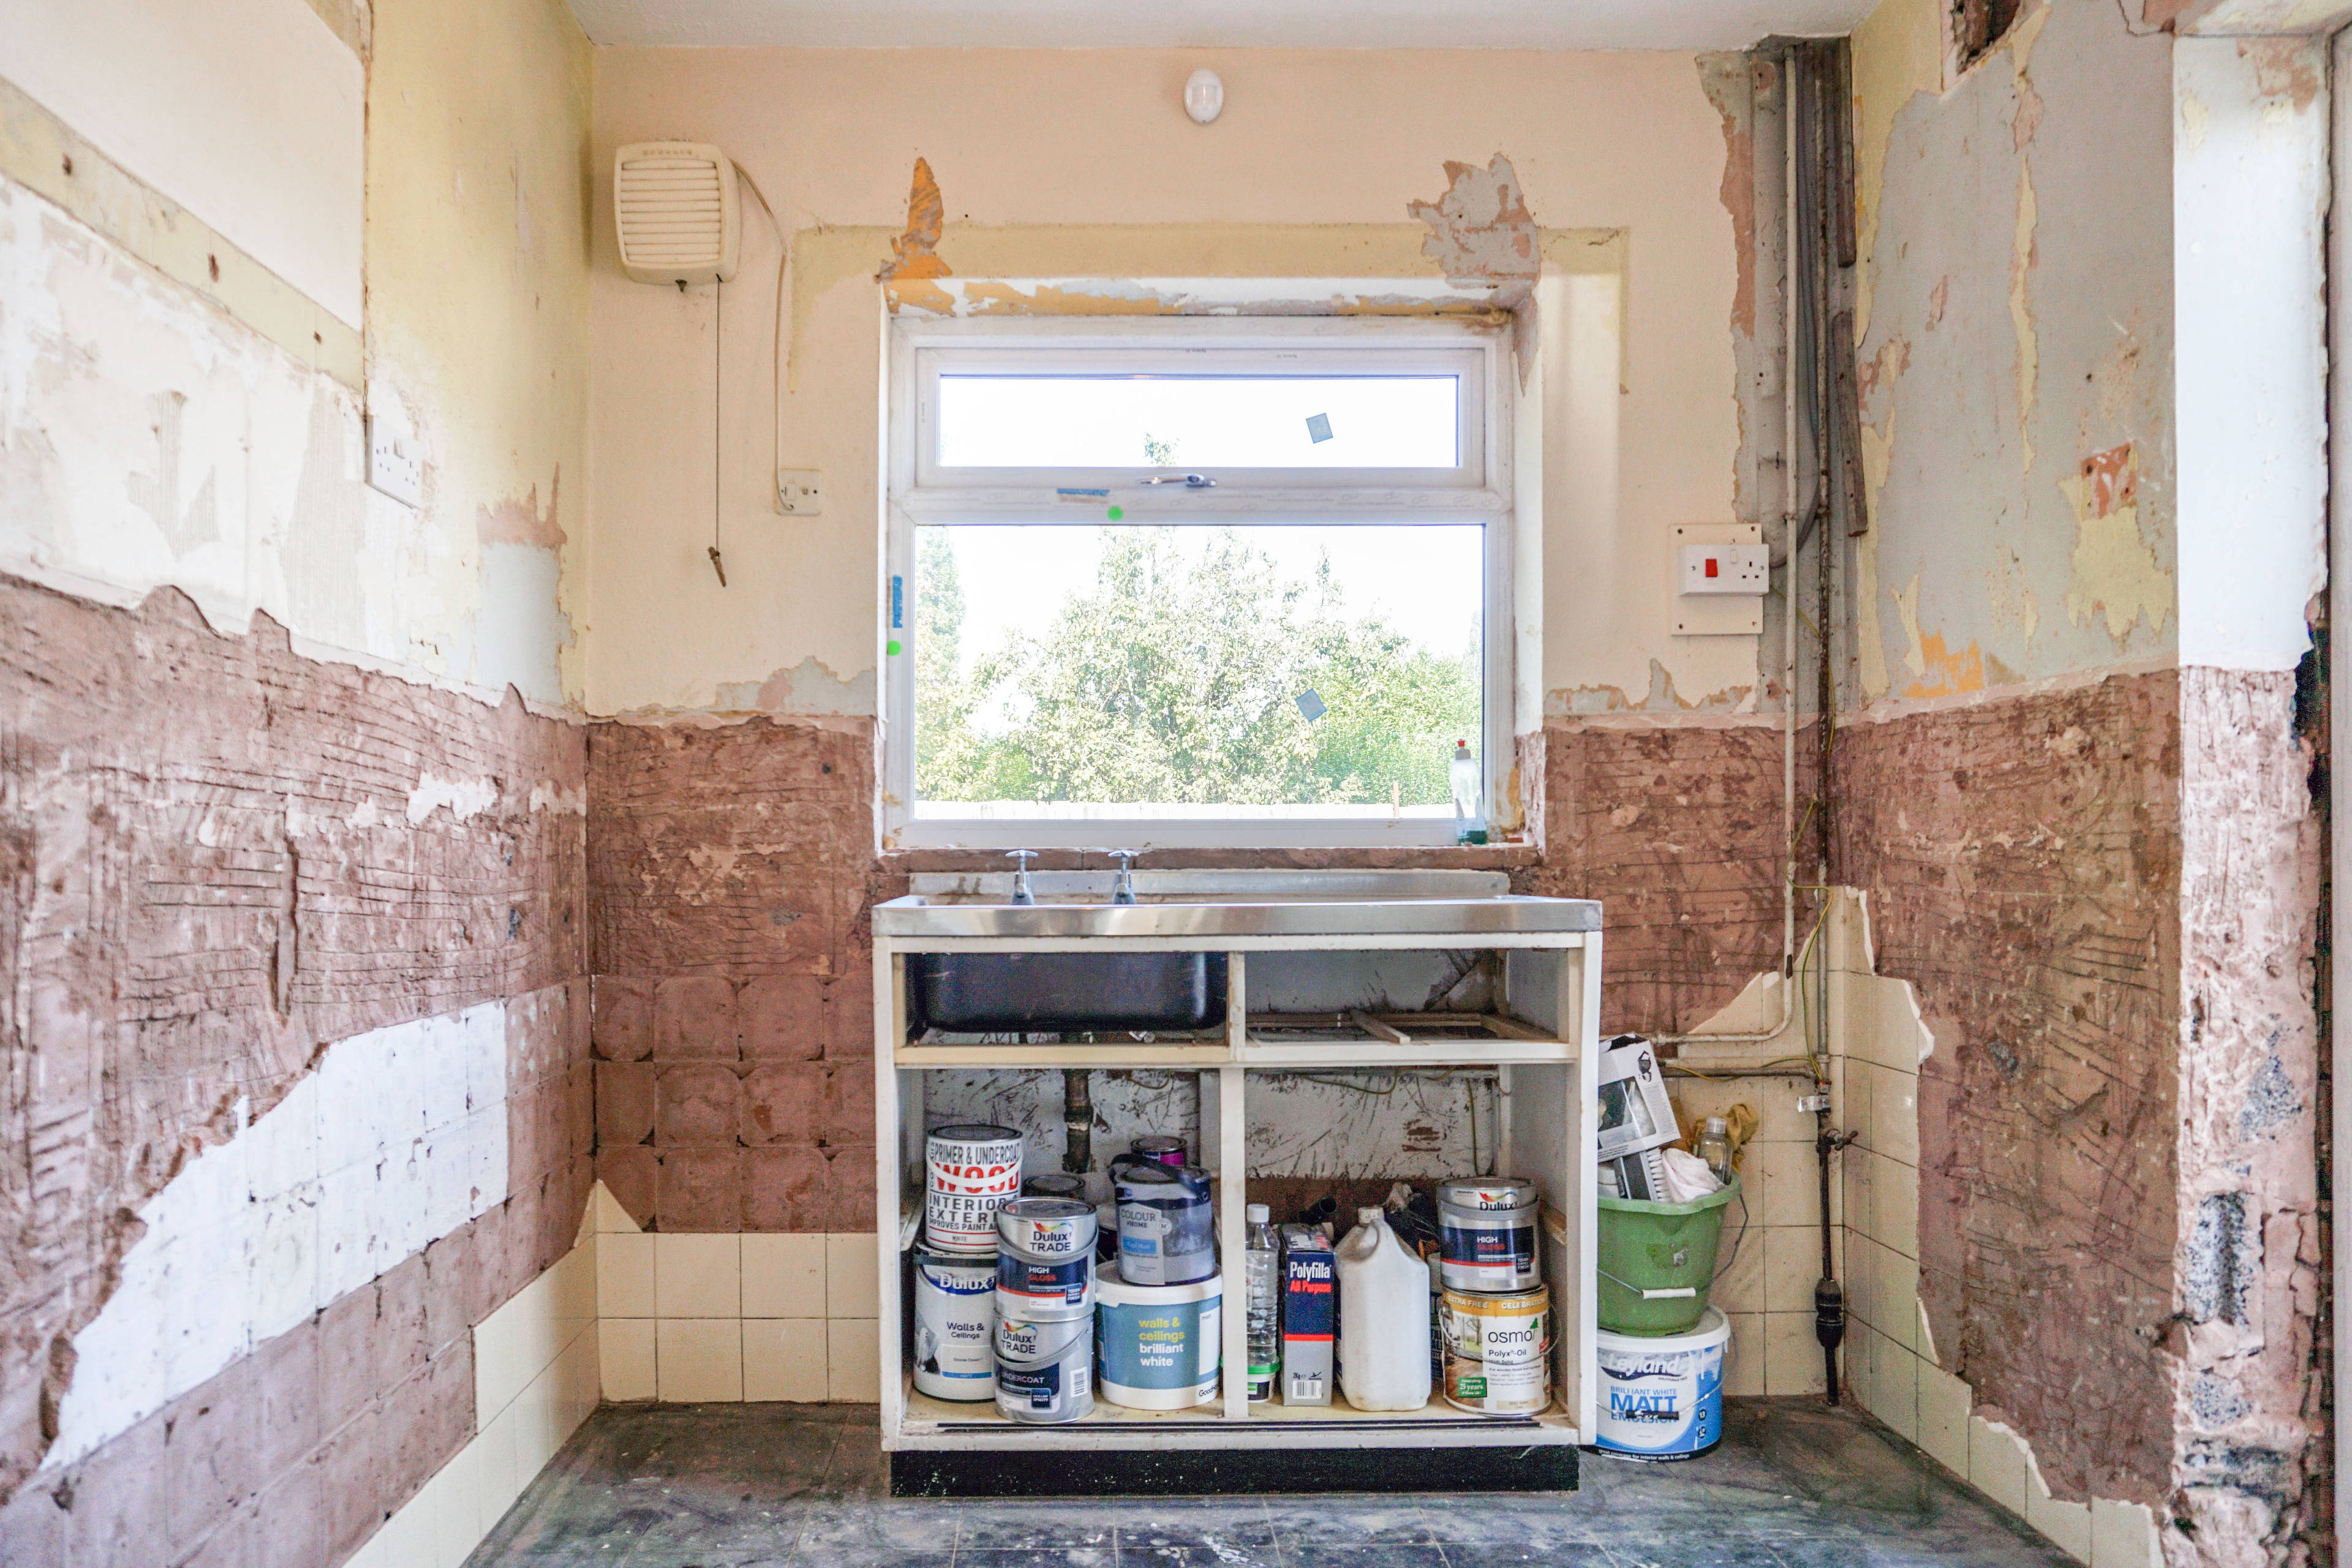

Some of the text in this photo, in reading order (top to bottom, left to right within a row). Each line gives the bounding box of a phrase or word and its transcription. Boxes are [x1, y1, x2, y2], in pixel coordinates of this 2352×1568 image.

[935, 1143, 1020, 1165] PRIMER & UNDERCOAT
[935, 1163, 1019, 1194] WOOD
[1479, 1202, 1515, 1211] Dulux
[1121, 1208, 1156, 1221] COLOUR
[929, 1217, 959, 1230] IMPROVES
[1033, 1231, 1068, 1242] Dulux
[1030, 1242, 1071, 1251] TRADE
[1289, 1261, 1330, 1282] Polyfilla
[940, 1273, 989, 1290] Dulux
[1448, 1295, 1466, 1306] EXTRA
[1468, 1300, 1488, 1309] FREE
[947, 1322, 984, 1332] Walls &
[1139, 1317, 1180, 1328] walls &
[1003, 1329, 1032, 1343] Dulux
[1139, 1330, 1185, 1343] ceilings
[1488, 1330, 1532, 1343] osmo
[1001, 1340, 1036, 1354] TRADE
[1139, 1343, 1184, 1354] brilliant
[1140, 1356, 1174, 1366] white
[1610, 1353, 1680, 1377] Leyland
[1001, 1371, 1046, 1384] UNDERCOAT
[1610, 1385, 1650, 1395] BRILLIANT
[1611, 1392, 1678, 1413] MATT
